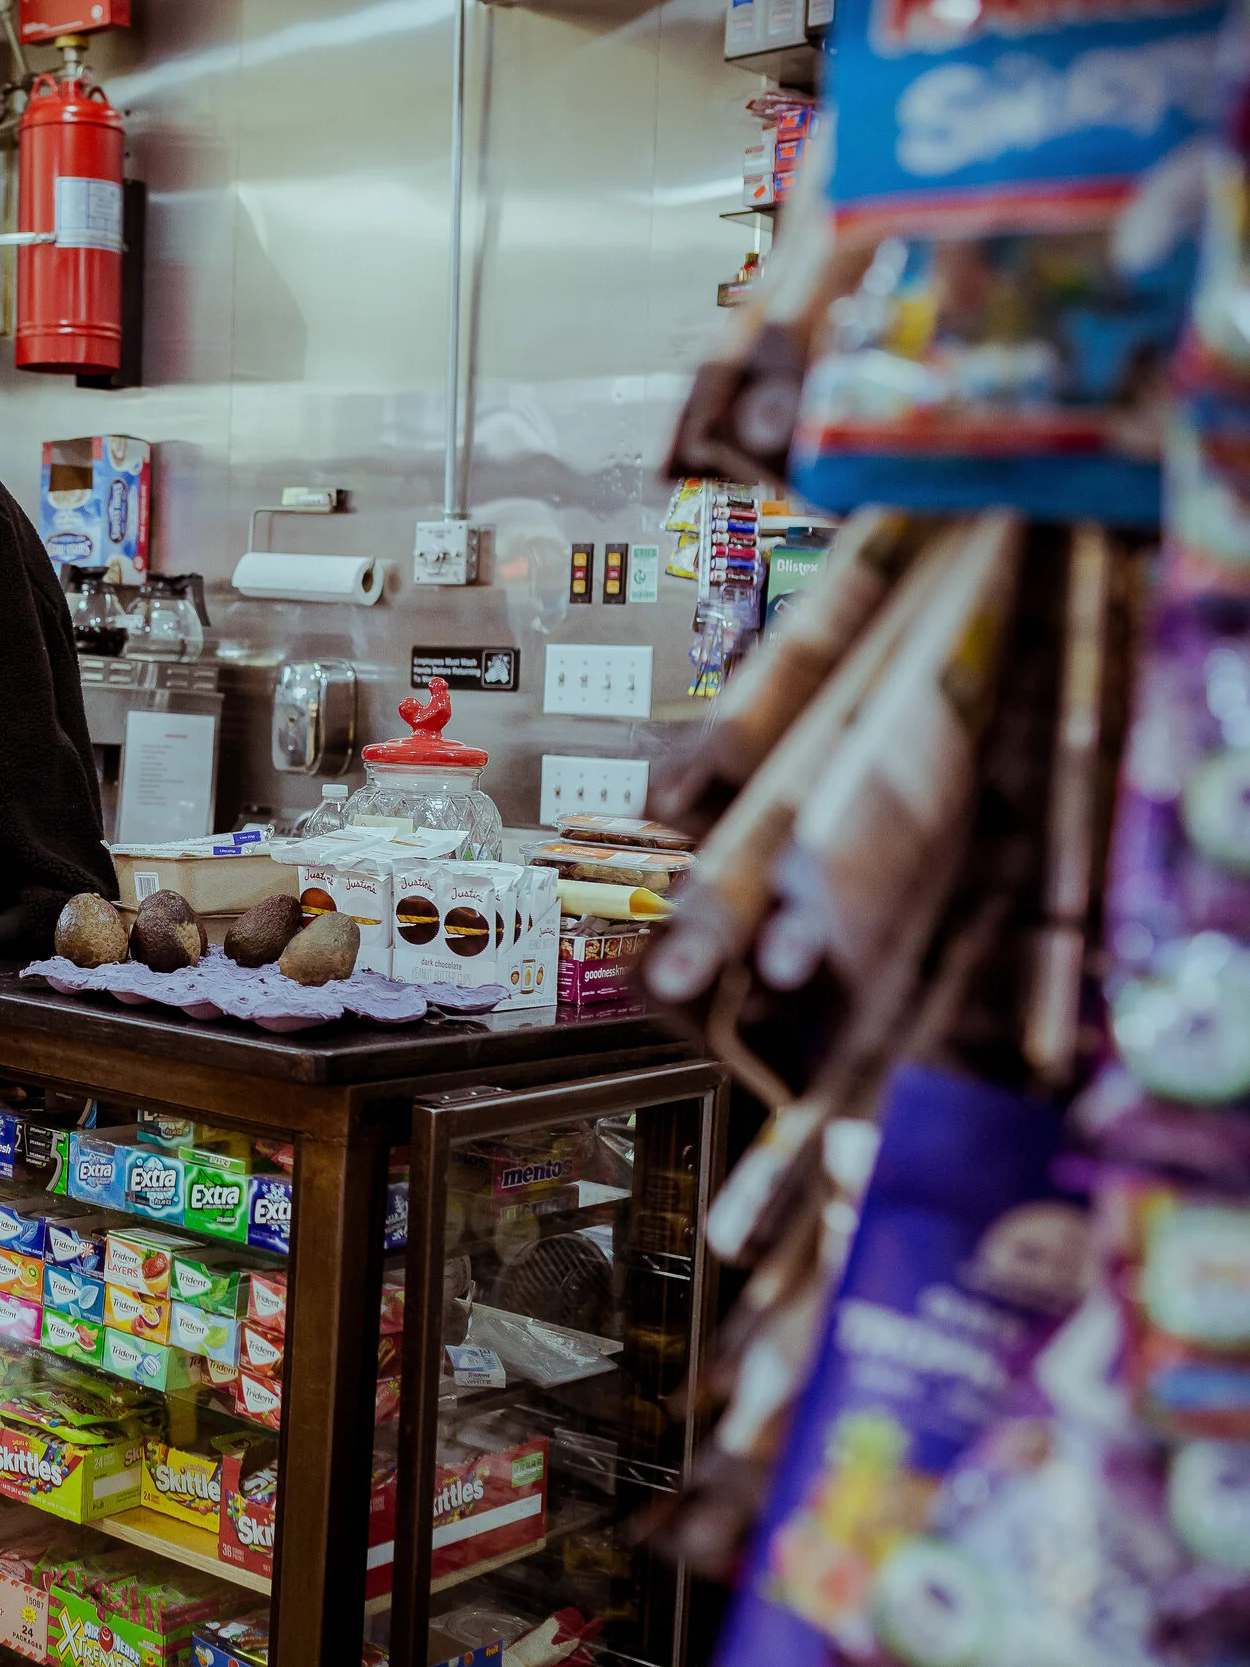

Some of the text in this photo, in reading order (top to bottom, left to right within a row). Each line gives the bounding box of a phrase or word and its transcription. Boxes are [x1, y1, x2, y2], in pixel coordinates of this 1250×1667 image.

[777, 558, 819, 576] Blistex
[304, 868, 335, 887] Justin's
[346, 877, 378, 895] Justin's
[401, 876, 434, 892] Justin's
[421, 957, 463, 971] dark chocolate
[411, 967, 472, 986] PEANUT BUTTER CUPS
[46, 1131, 65, 1192] 5
[80, 1162, 112, 1181] Extra
[131, 1167, 177, 1192] Extra
[501, 1159, 574, 1189] mentos
[191, 1184, 240, 1209] Extra
[53, 1238, 78, 1253] Trident
[111, 1249, 138, 1264] Trident
[107, 1262, 138, 1279] LAYERS
[52, 1281, 77, 1296] Trident
[178, 1272, 207, 1288] Trident
[113, 1298, 139, 1313] Trident
[255, 1291, 280, 1309] Trident
[50, 1323, 75, 1339] Trident
[179, 1318, 205, 1334] Trident
[112, 1345, 138, 1362] Trident
[249, 1340, 276, 1358] Trident
[246, 1387, 274, 1405] Trident
[155, 1464, 221, 1502] Skittle
[433, 1478, 484, 1517] kittles
[21, 1624, 34, 1638] 24
[12, 1631, 43, 1651] PACKAGES
